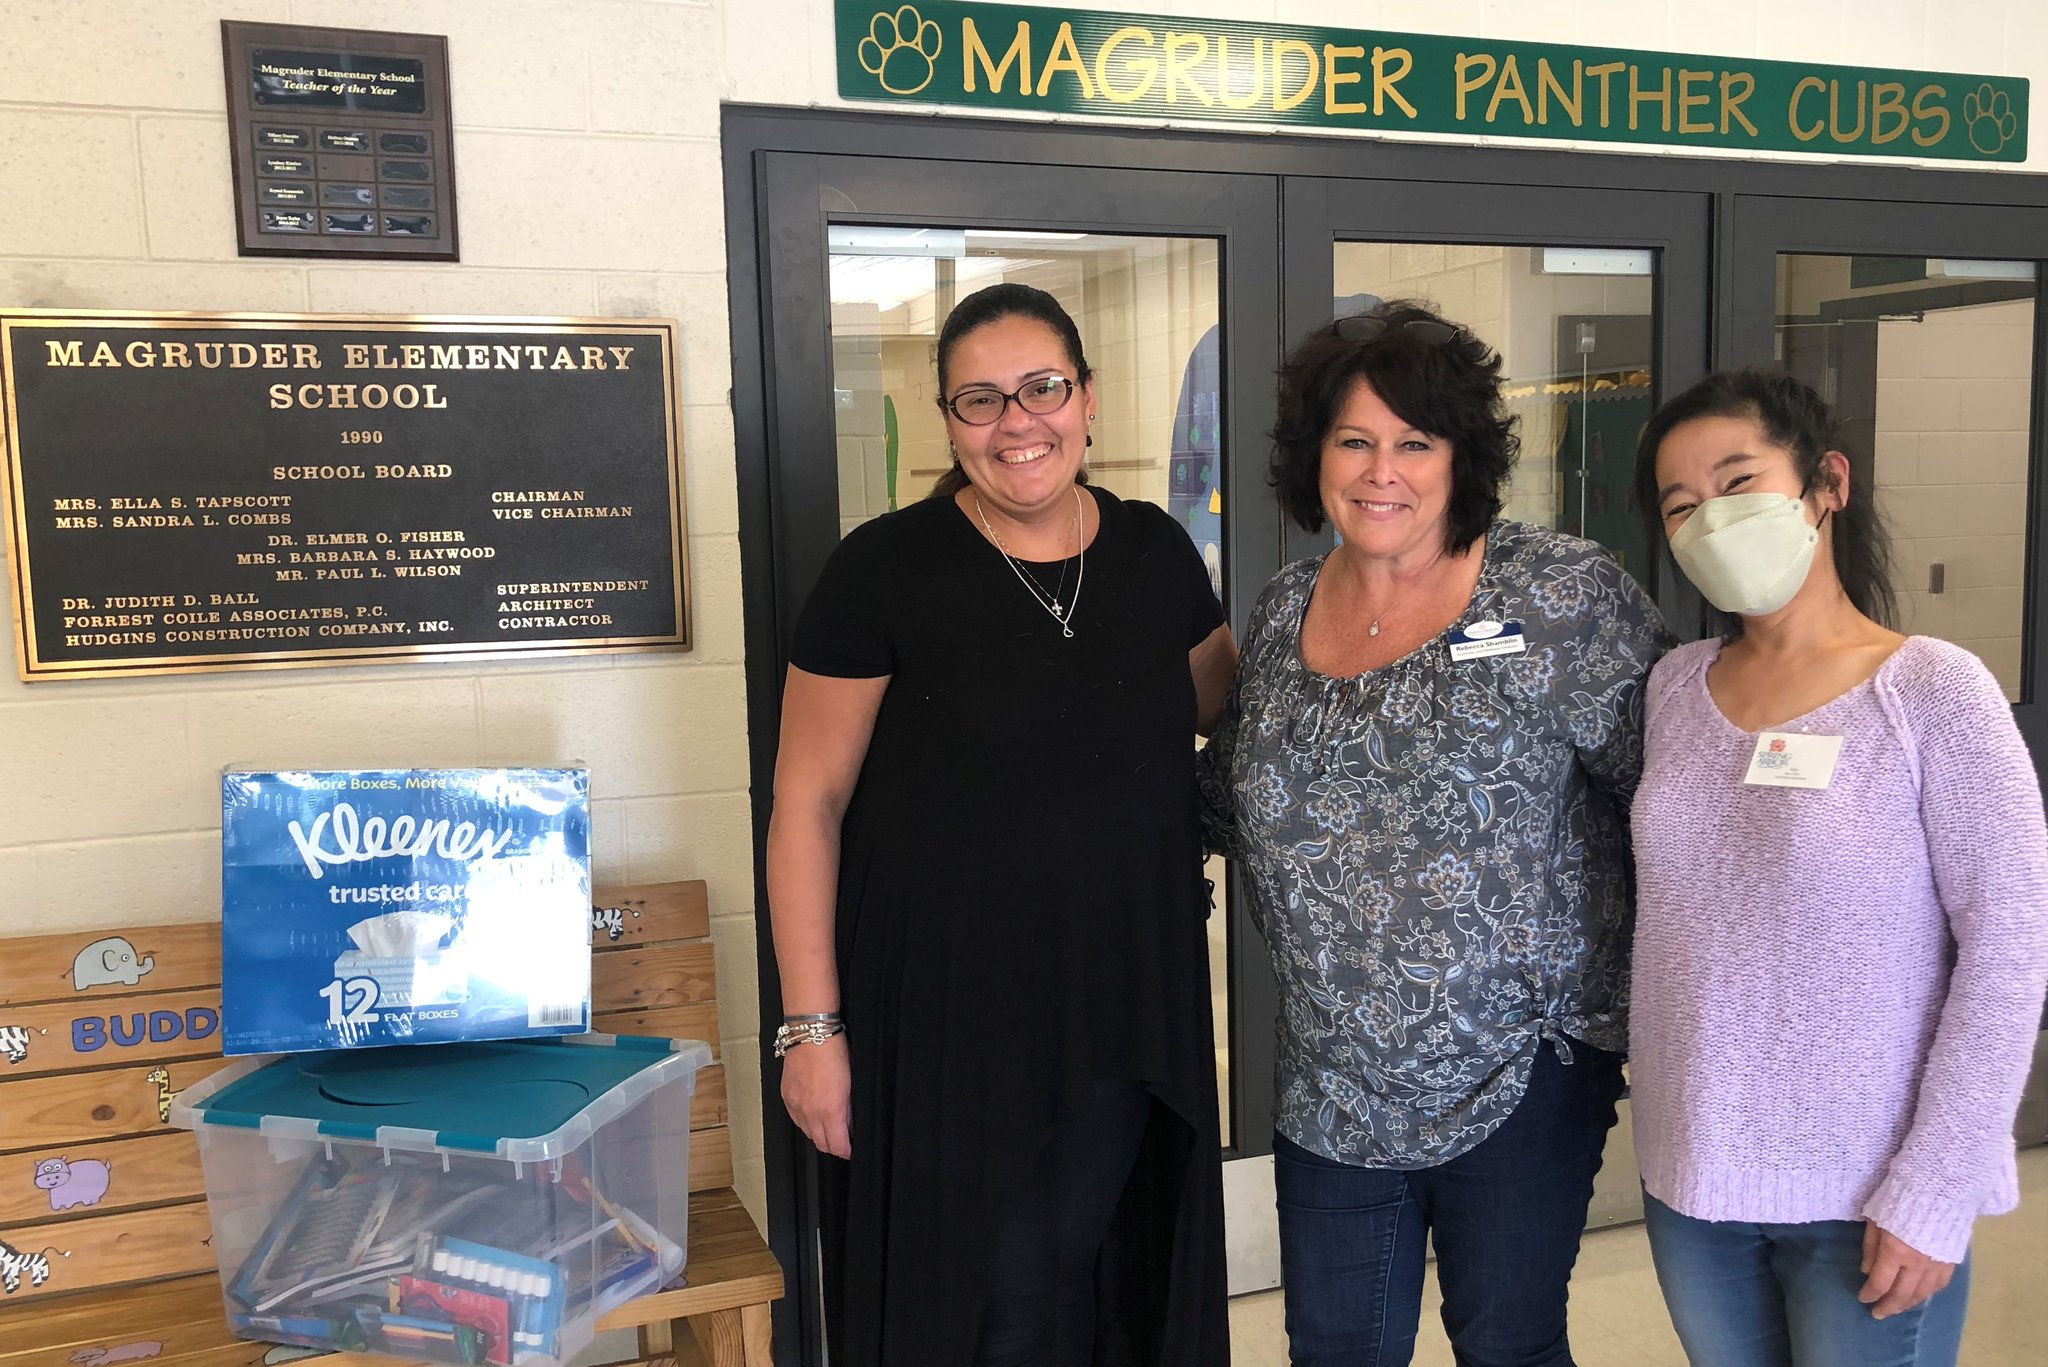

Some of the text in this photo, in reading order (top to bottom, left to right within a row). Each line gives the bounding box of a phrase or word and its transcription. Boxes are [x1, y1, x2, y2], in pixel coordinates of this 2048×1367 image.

[261, 64, 415, 83] Magruder Elementary School
[962, 17, 1950, 147] MAGRUDER PANTHER CUBS
[282, 79, 397, 96] Teacher of the Year
[45, 341, 634, 371] MAGRUDER ELEMENTARY
[269, 383, 447, 410] SCHOOL
[341, 430, 383, 445] 1990
[273, 464, 452, 481] SCHOOL BOARD
[54, 495, 292, 511] MRS. ELLA S. TAPSCOTT
[491, 490, 585, 503] CHAIRMAN
[55, 513, 292, 529] MRS. SANDRA L. COMBS
[491, 506, 633, 520] VICE CHAIRMAN
[268, 531, 466, 546] DR. ELMER O. FISHER
[236, 547, 496, 565] MRS. BARBARA S. HAYWOOD
[276, 565, 462, 582] MR. PAUL L. WILSON
[497, 580, 649, 596] SUPERINTENDENT
[62, 593, 260, 610] DR. JUDITH D. BALL
[498, 598, 595, 612] ARCHITECT
[64, 606, 388, 628] FORREST COILE ASSOCIATES, P.C.
[498, 614, 613, 630] CONTRACTOR
[65, 620, 454, 647] HUDGINS CONSTRUCTION COMPANY, INC.
[1456, 642, 1484, 652] Rebecca
[1485, 638, 1518, 648] Shamblin
[350, 777, 402, 792] Boxes,
[405, 777, 445, 789] More
[288, 802, 512, 880] Kleenex
[329, 880, 420, 903] trusted
[319, 977, 380, 1025] 12
[384, 1009, 459, 1022] FLAT BOXES
[72, 1007, 222, 1052] BUDD
